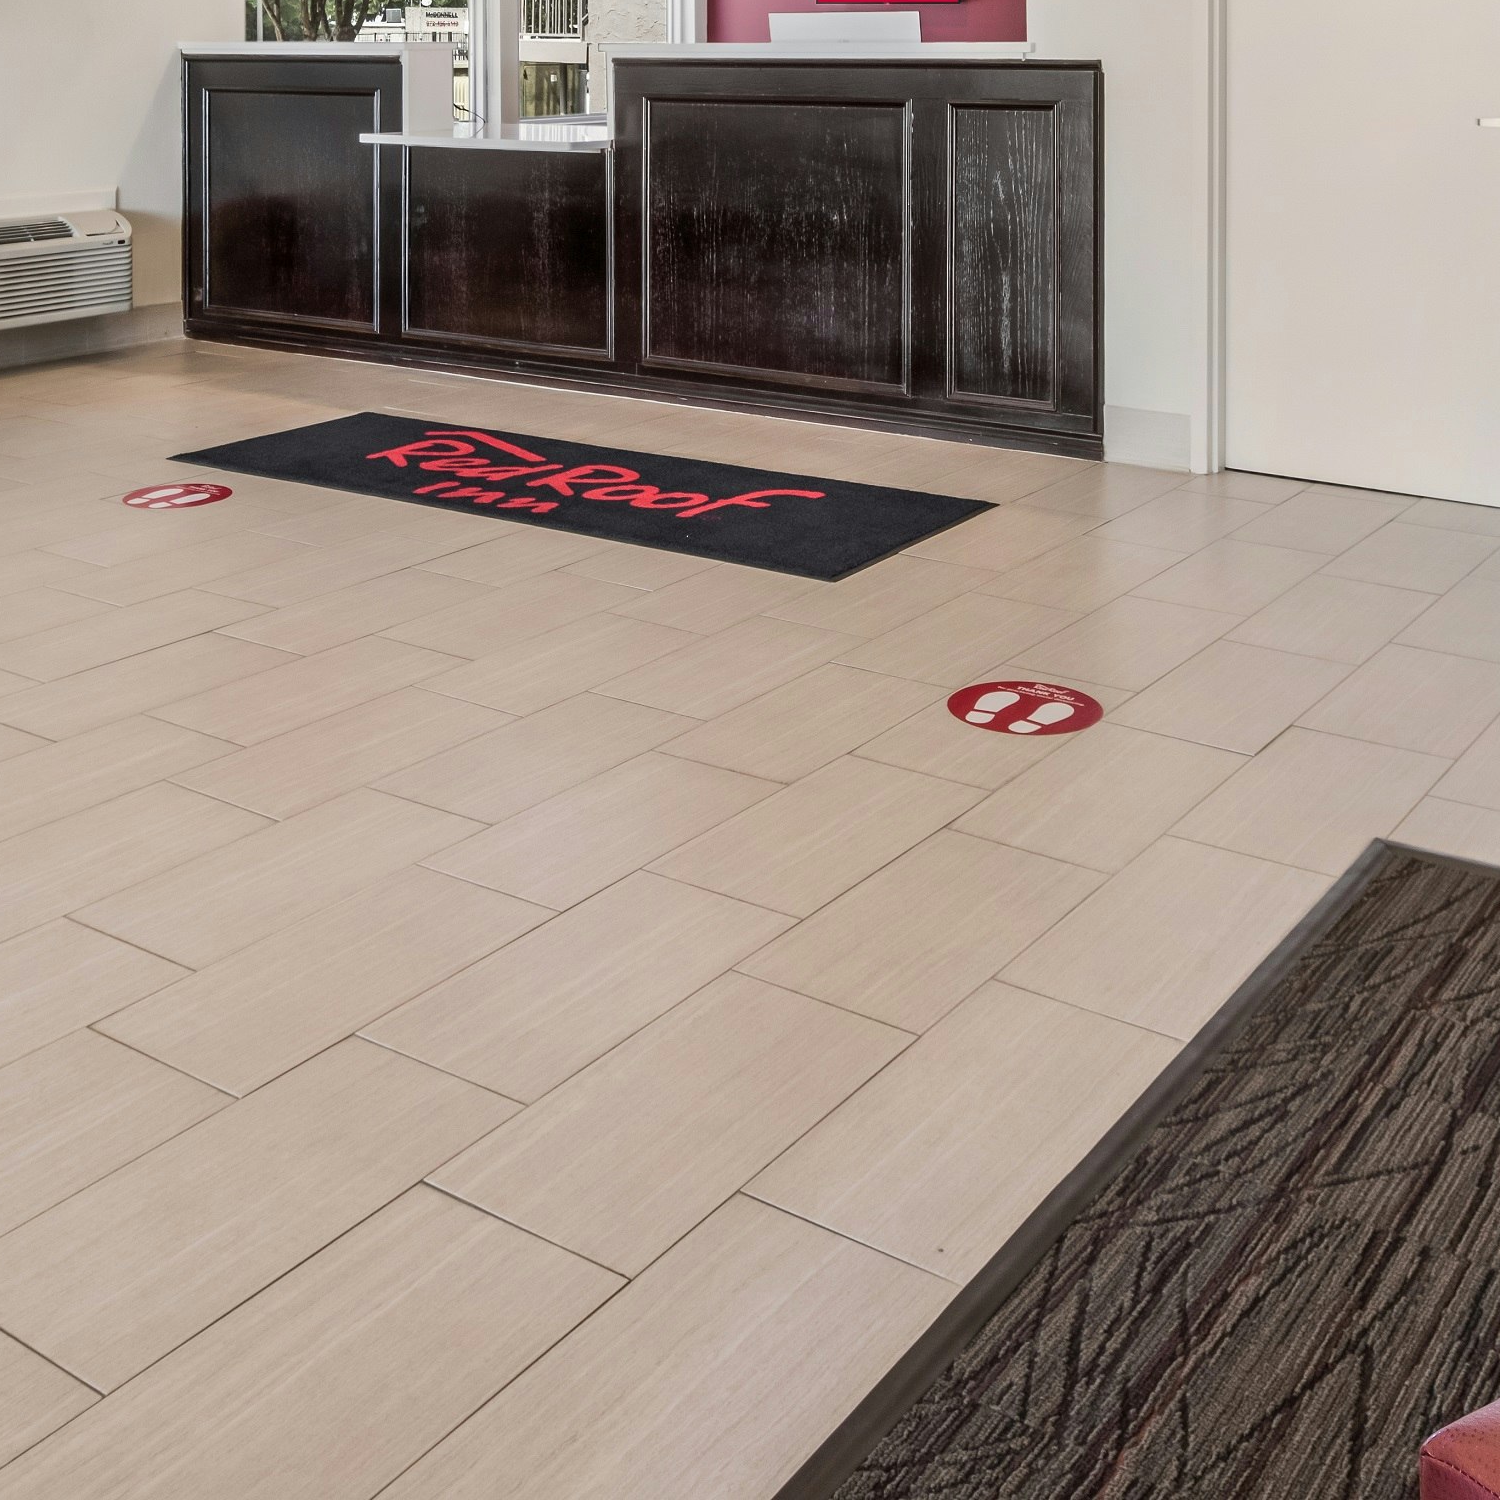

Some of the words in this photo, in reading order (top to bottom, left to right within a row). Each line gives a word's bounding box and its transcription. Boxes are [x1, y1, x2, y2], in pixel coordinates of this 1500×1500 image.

[366, 438, 563, 481] Red
[526, 464, 826, 518] Roof
[412, 481, 561, 514] Inn
[1017, 686, 1051, 696] THANK
[1053, 693, 1075, 701] YOU
